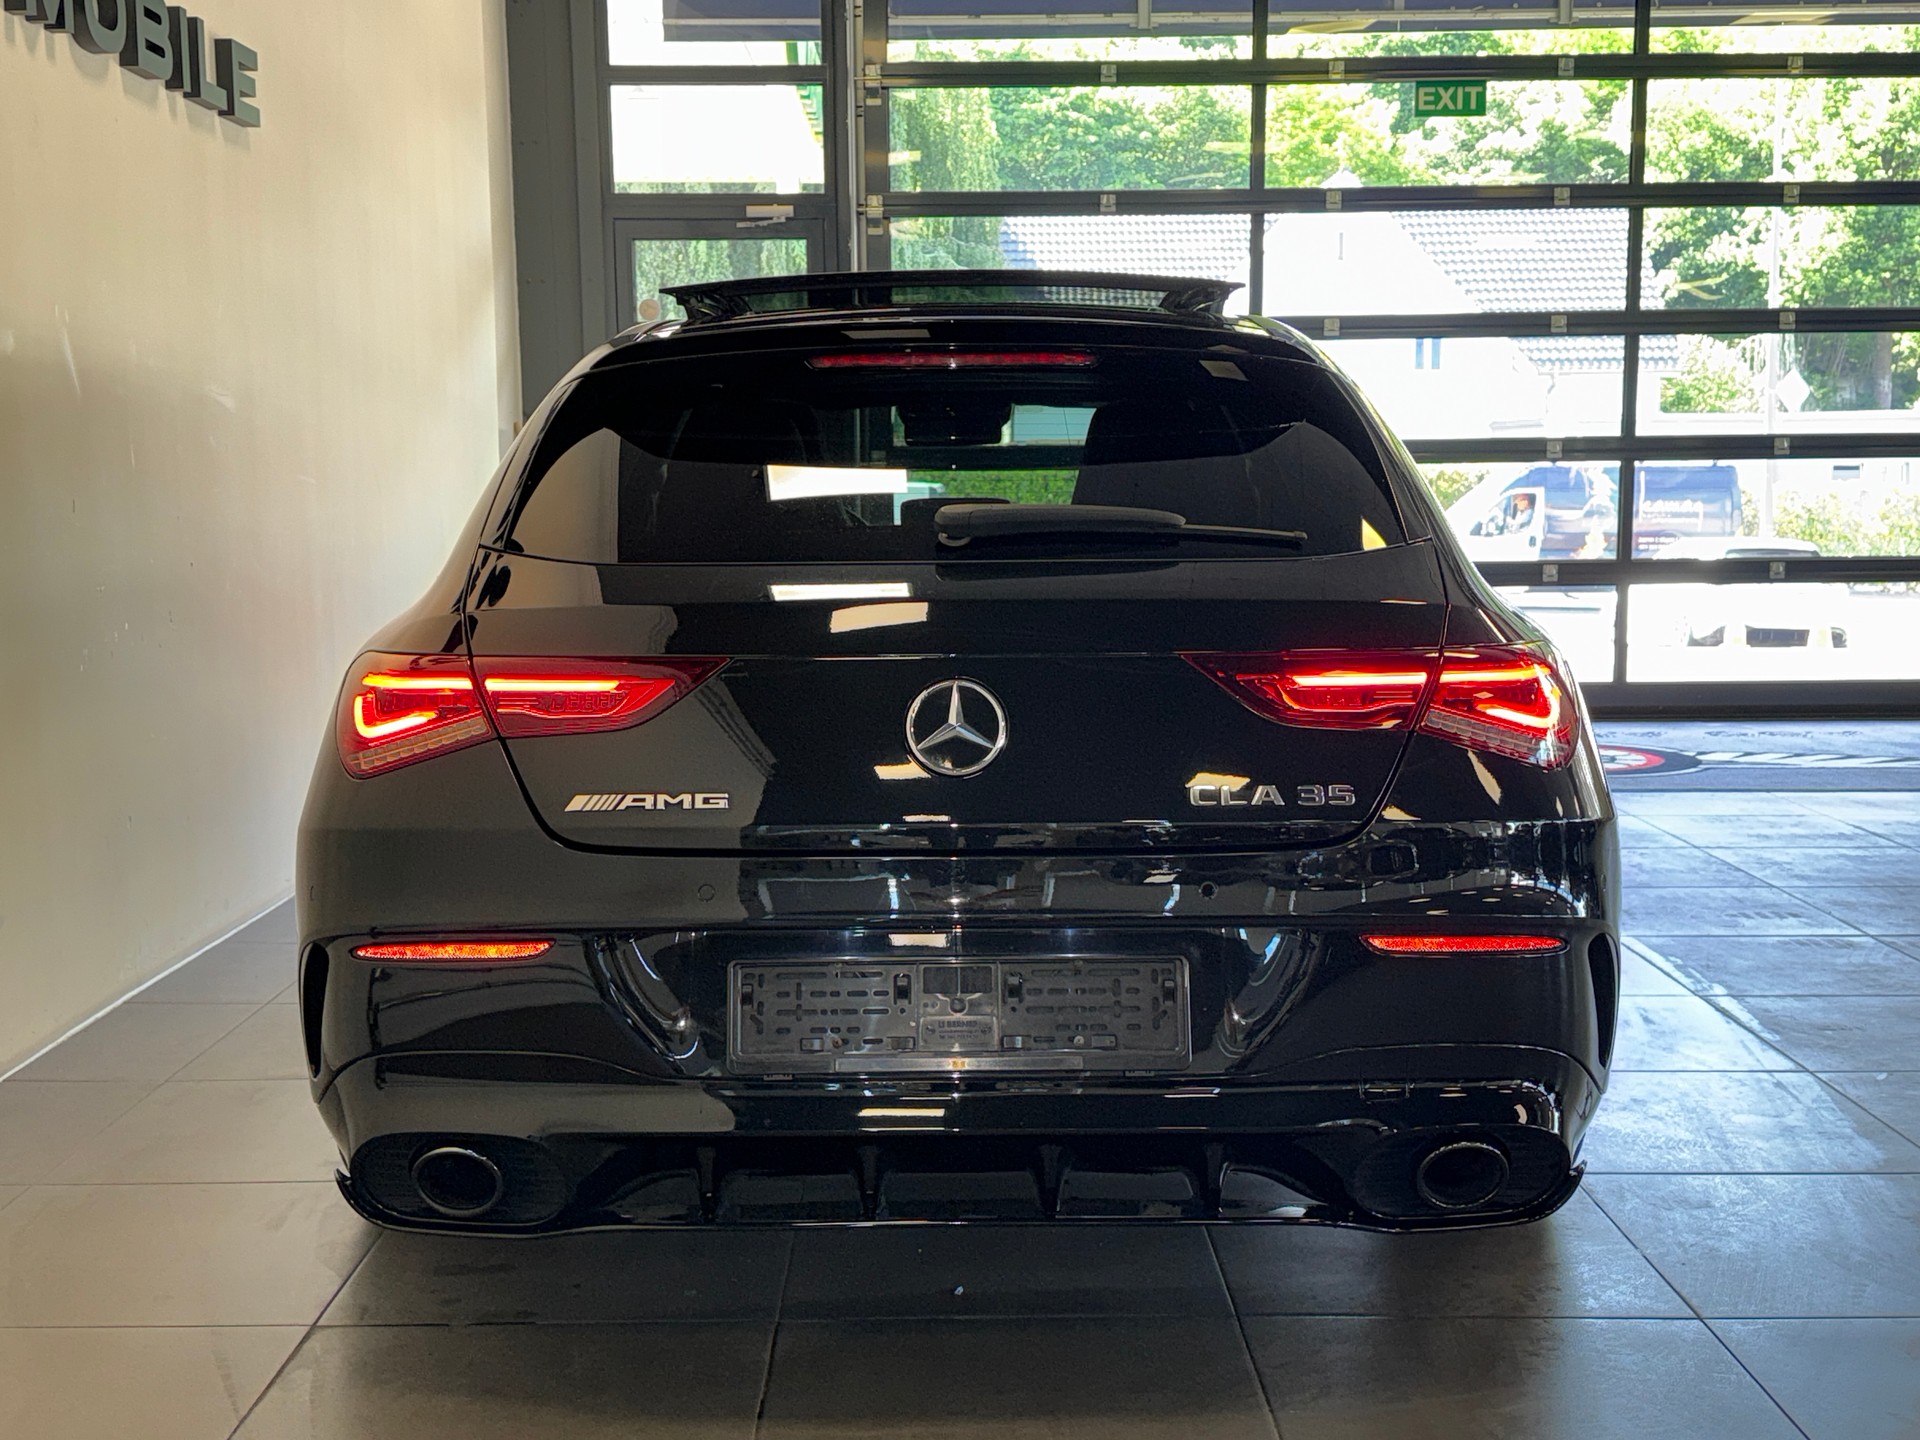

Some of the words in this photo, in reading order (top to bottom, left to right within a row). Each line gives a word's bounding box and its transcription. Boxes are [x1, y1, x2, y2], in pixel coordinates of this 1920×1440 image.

[1418, 86, 1483, 110] EXIT
[616, 793, 729, 811] AMG
[1190, 785, 1285, 806] CLA
[1297, 784, 1356, 806] 35
